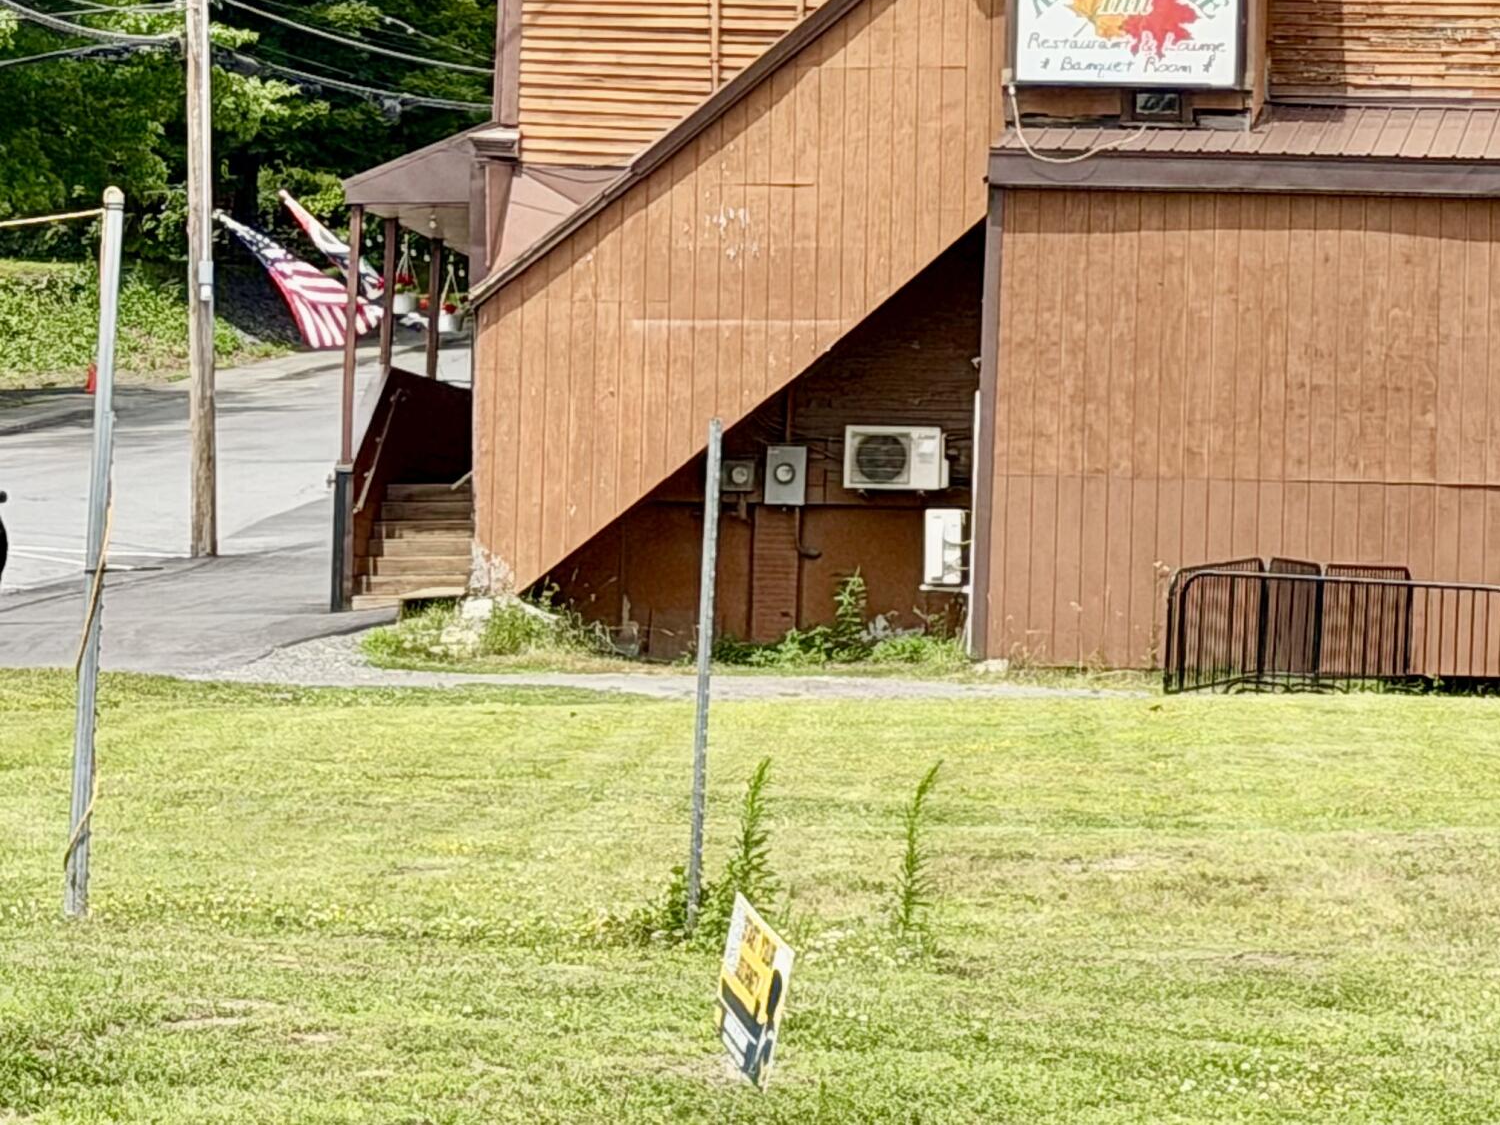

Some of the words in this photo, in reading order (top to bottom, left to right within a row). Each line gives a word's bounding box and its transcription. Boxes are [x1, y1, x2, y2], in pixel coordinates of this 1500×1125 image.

[1027, 32, 1132, 50] Restaurant
[1060, 56, 1135, 78] Banquet
[1143, 56, 1192, 73] Room
